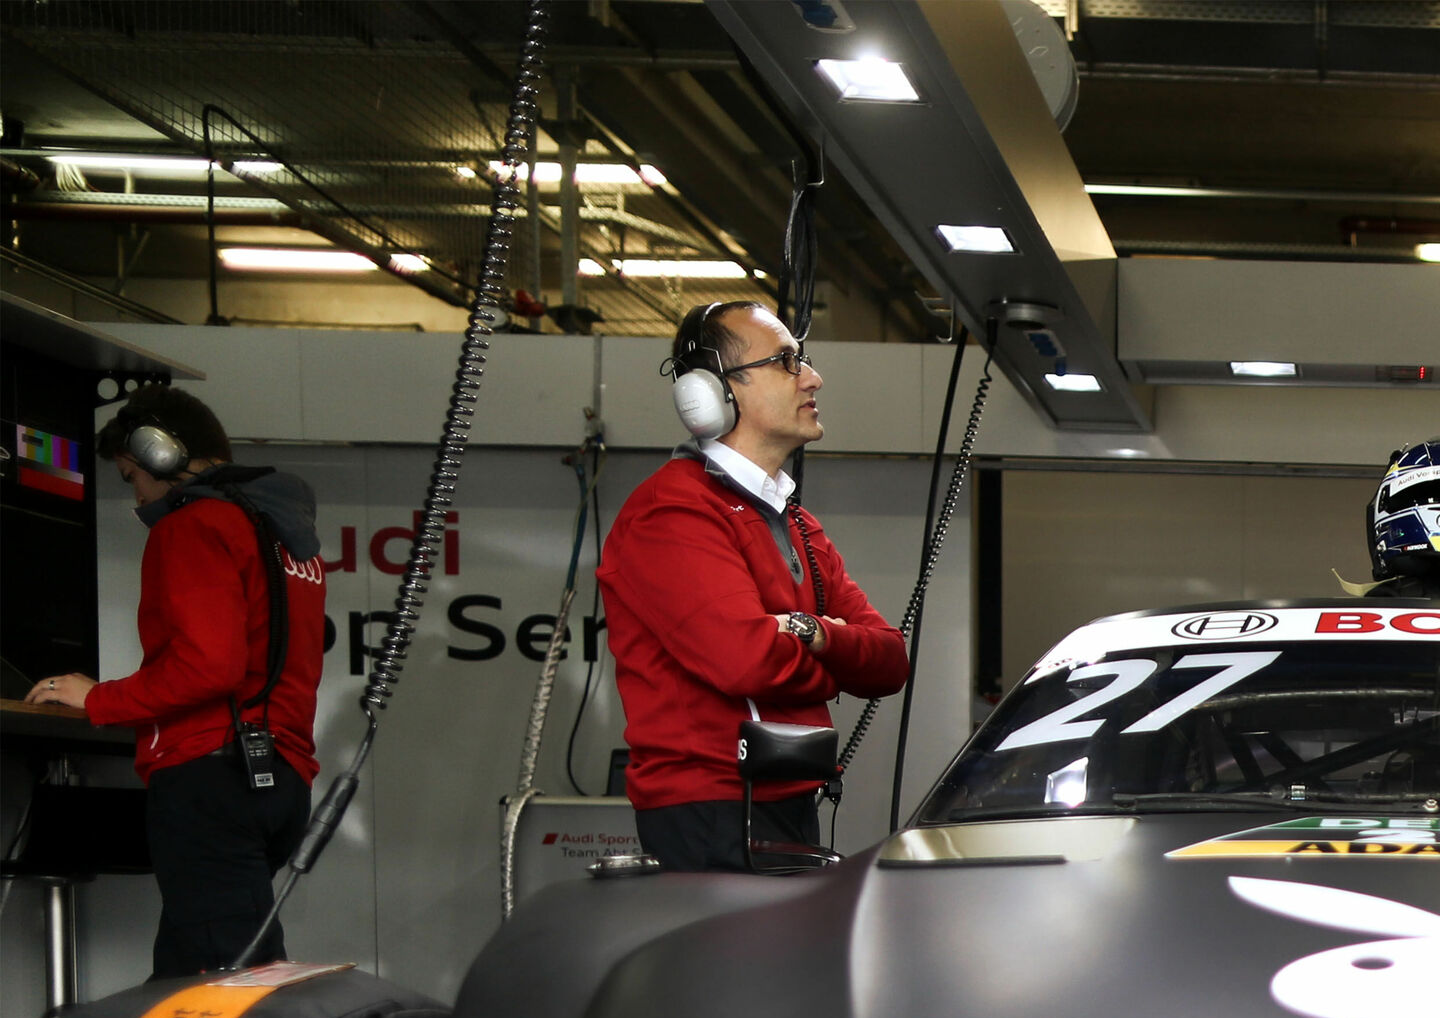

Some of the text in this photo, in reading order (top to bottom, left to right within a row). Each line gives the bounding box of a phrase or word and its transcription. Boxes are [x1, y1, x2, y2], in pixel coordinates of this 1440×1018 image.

[324, 511, 459, 575] udi
[995, 651, 1283, 751] 27
[561, 834, 594, 843] Audi
[561, 847, 599, 857] Team
